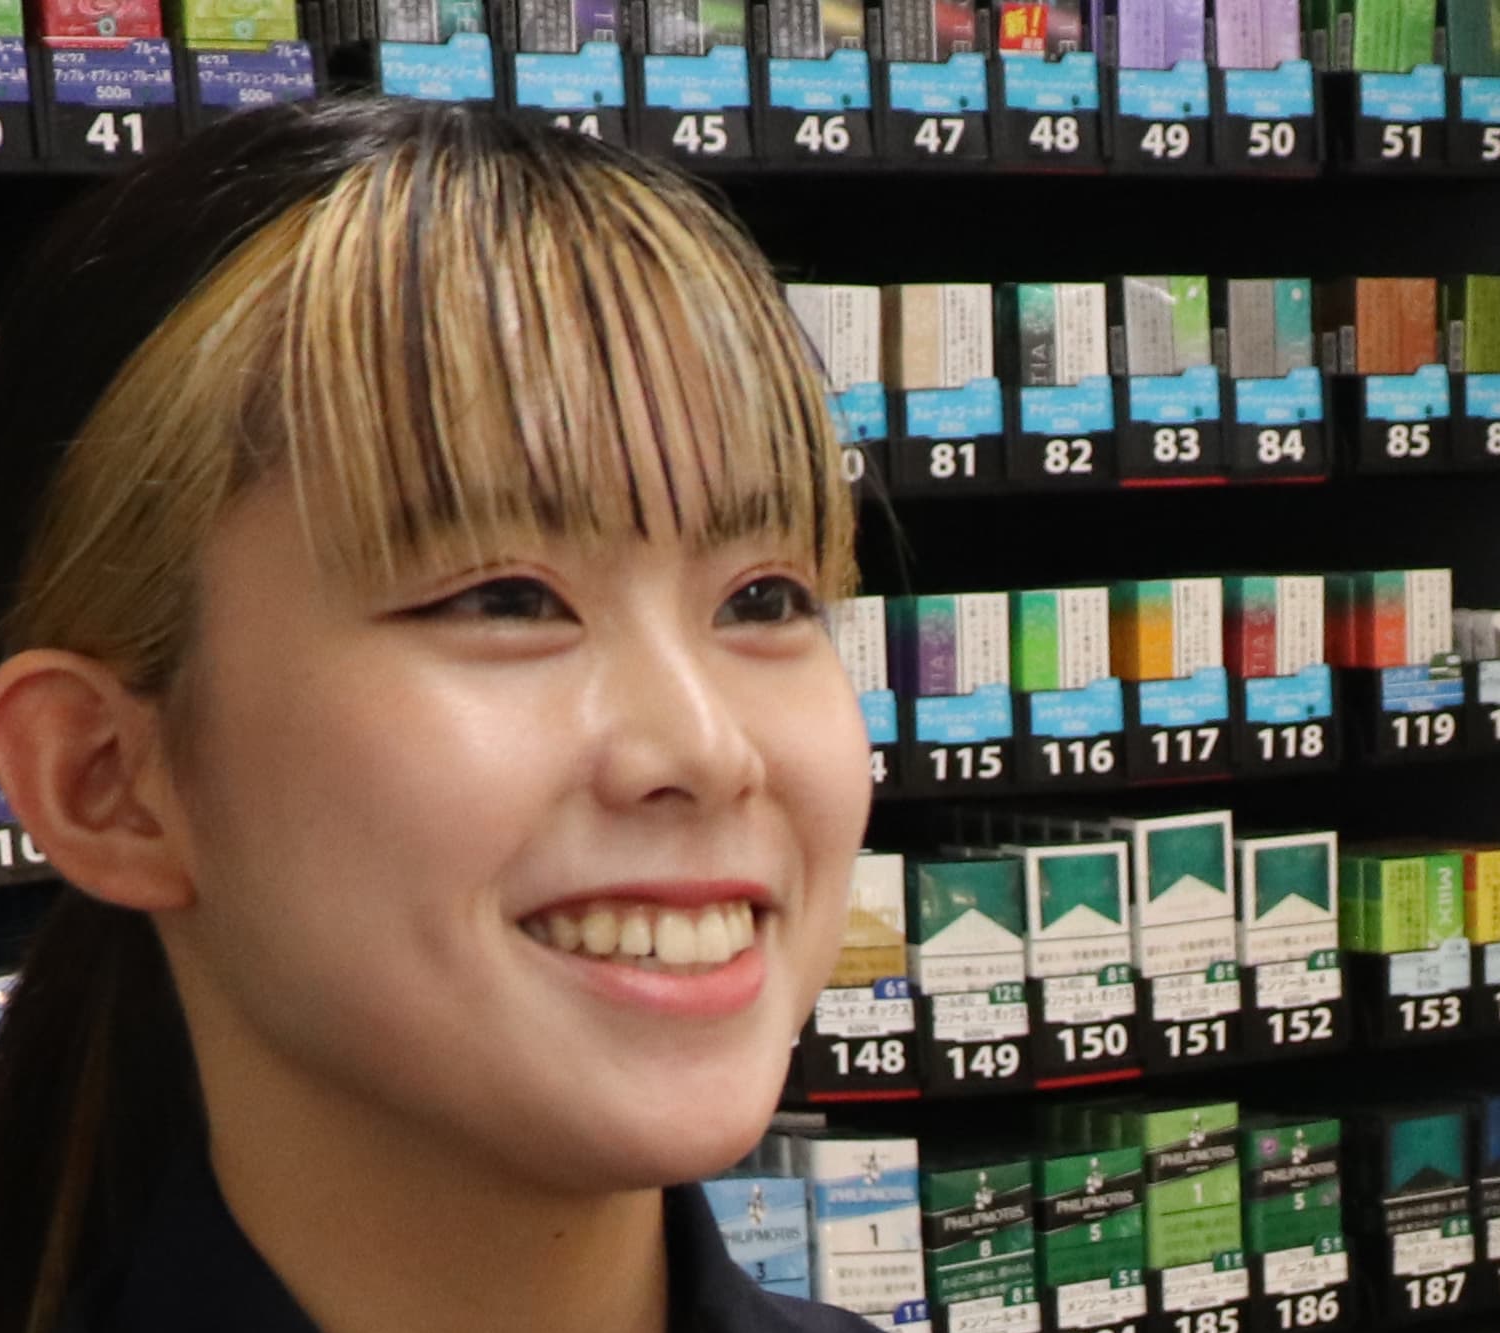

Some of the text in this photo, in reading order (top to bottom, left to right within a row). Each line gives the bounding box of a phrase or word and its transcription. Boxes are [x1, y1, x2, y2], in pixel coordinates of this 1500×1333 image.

[87, 113, 142, 152] 41
[673, 116, 726, 152] 45
[796, 116, 849, 151] 46
[915, 119, 964, 152] 47
[1030, 117, 1078, 151] 48
[1142, 124, 1189, 157] 49
[1249, 123, 1294, 155] 50
[1382, 125, 1421, 157] 51
[1045, 439, 1092, 473] 82
[1154, 428, 1199, 461] 83
[1259, 430, 1304, 462] 84
[1387, 425, 1429, 456] 85
[931, 444, 974, 477] 81
[1043, 740, 1113, 774] 116
[1152, 728, 1218, 763] 117
[1258, 725, 1322, 759] 118
[930, 746, 1001, 779] 115
[1269, 1008, 1332, 1043] 152
[1400, 997, 1460, 1030] 153
[832, 1040, 904, 1074] 148
[1058, 1024, 1127, 1061] 150
[948, 1044, 1019, 1078] 149
[1277, 1291, 1338, 1328] 186
